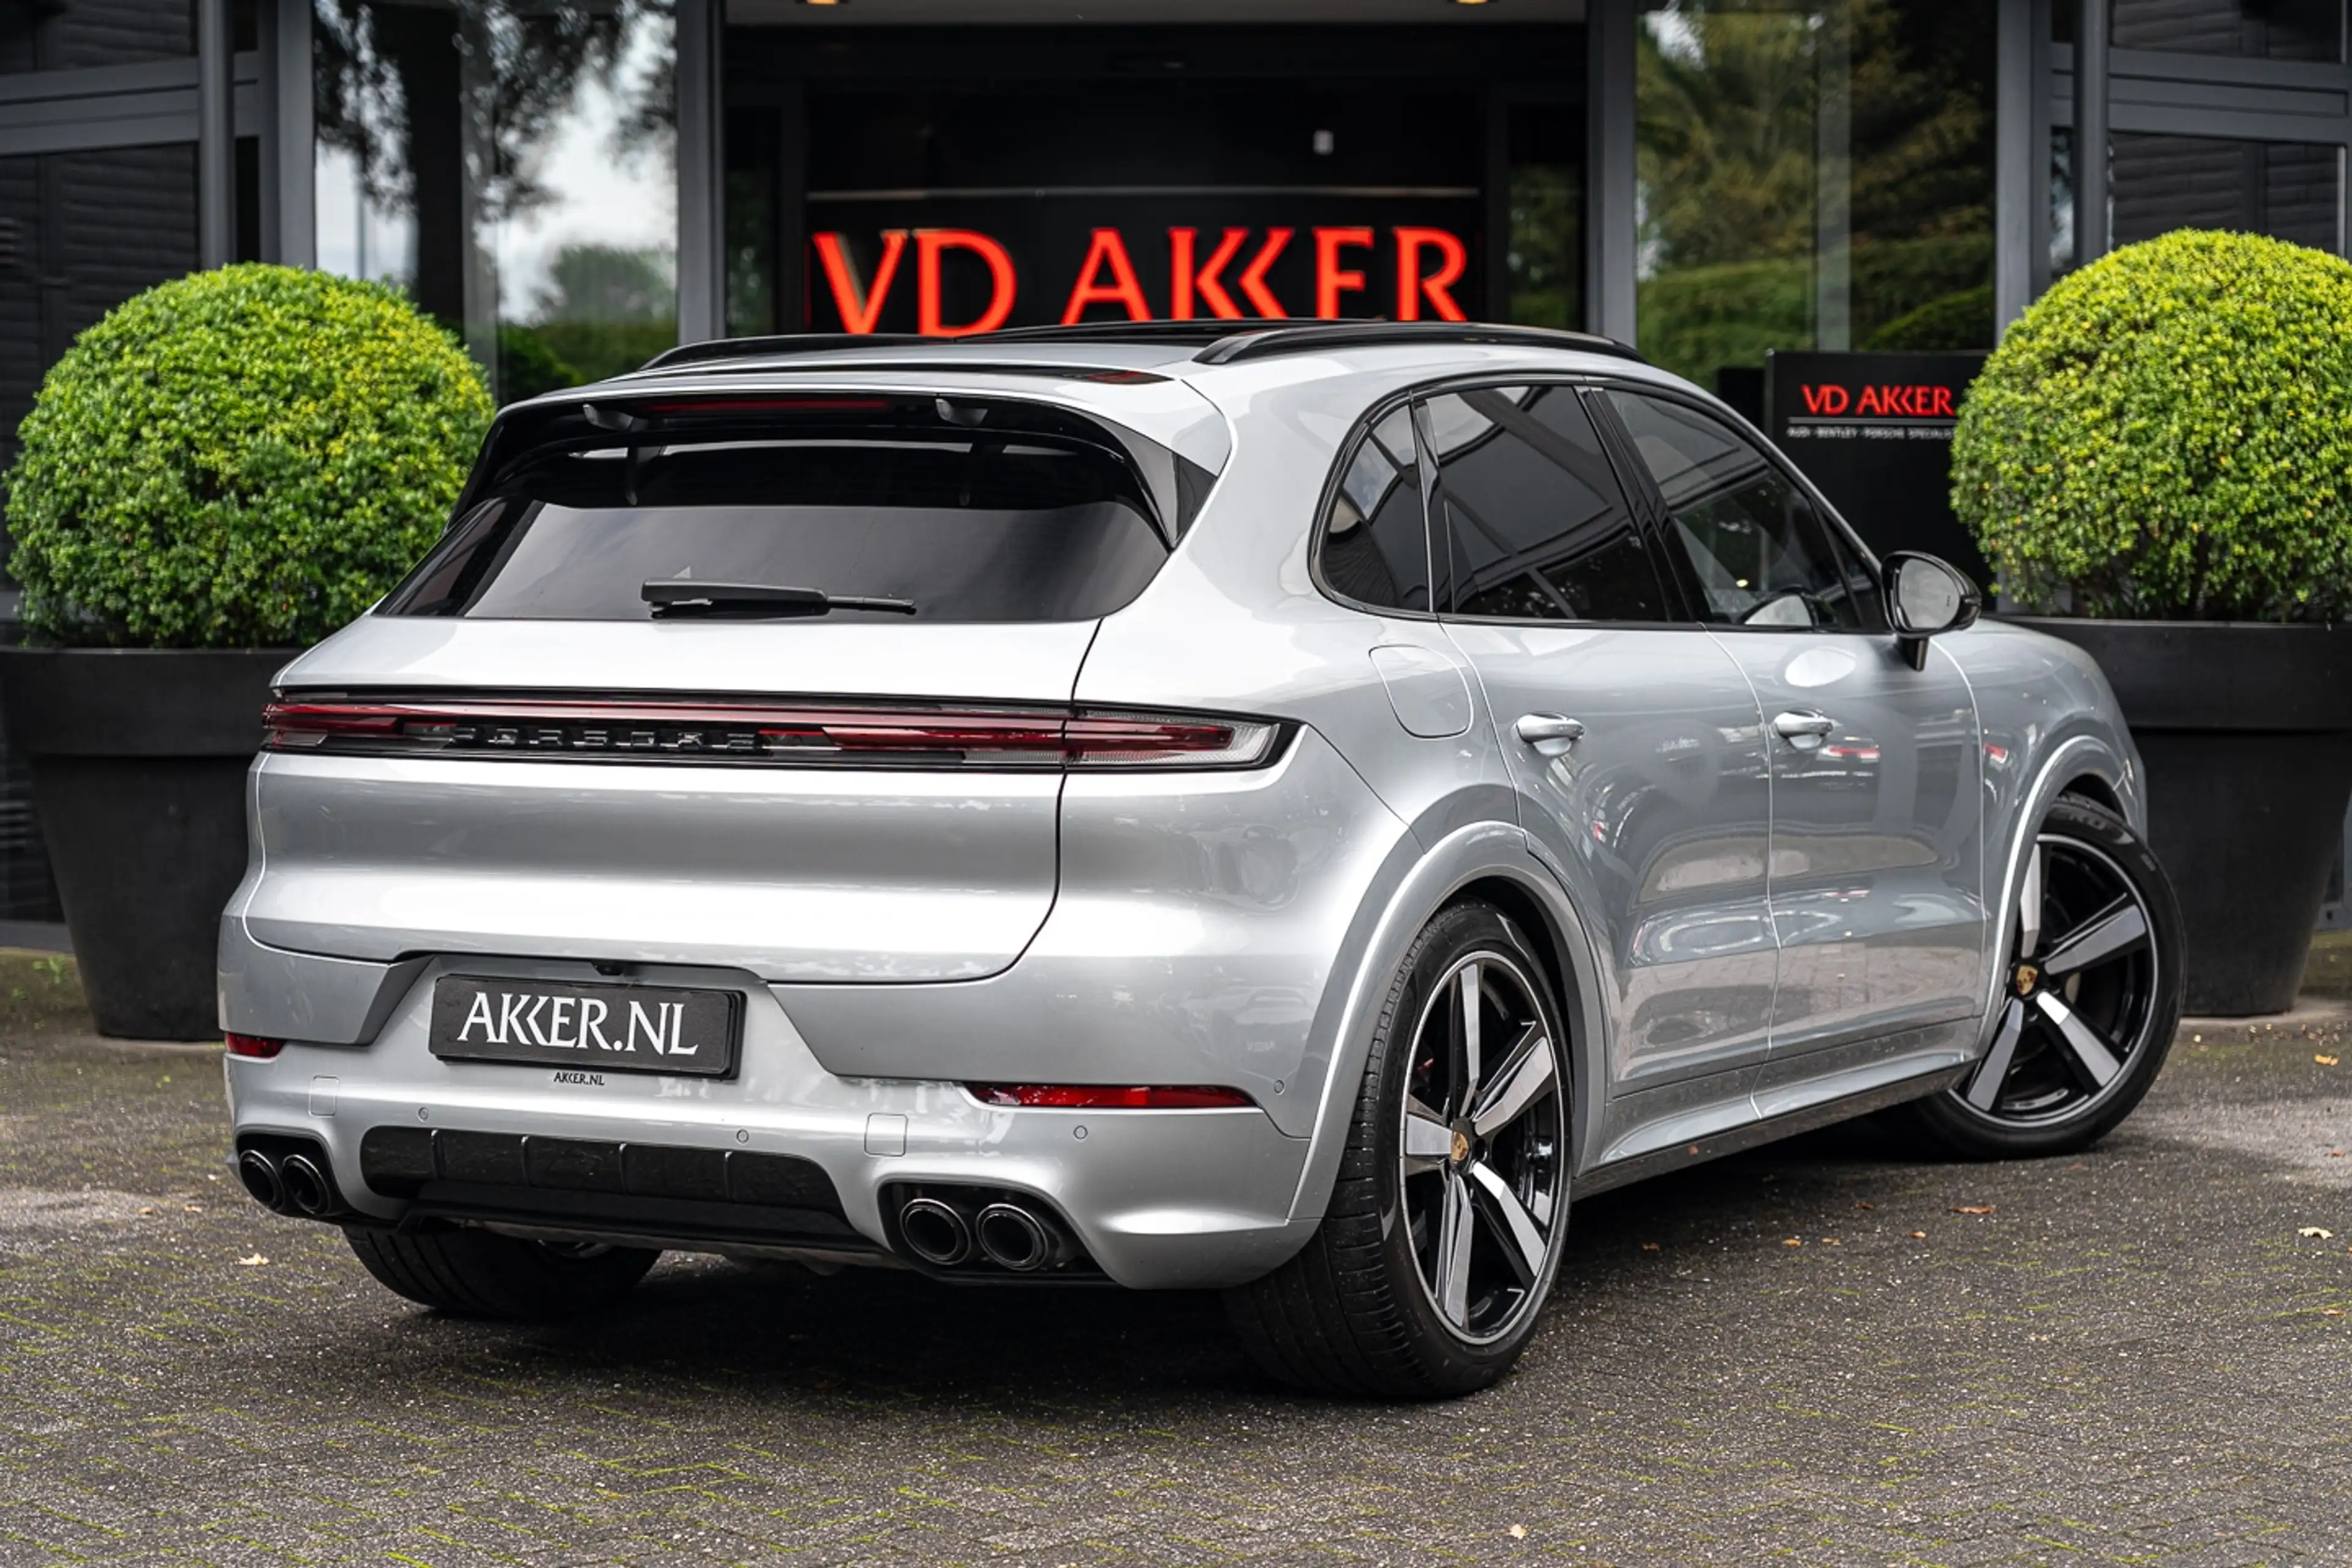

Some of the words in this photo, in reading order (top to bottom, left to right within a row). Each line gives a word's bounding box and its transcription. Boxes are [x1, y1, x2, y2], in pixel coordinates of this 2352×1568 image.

[812, 227, 1017, 336] VD
[1061, 227, 1468, 325] AKKER
[1801, 385, 1850, 415] VD
[1855, 385, 1955, 416] AKKER
[457, 991, 699, 1056] AKKER.NL
[553, 1071, 605, 1087] AKKER.NL
